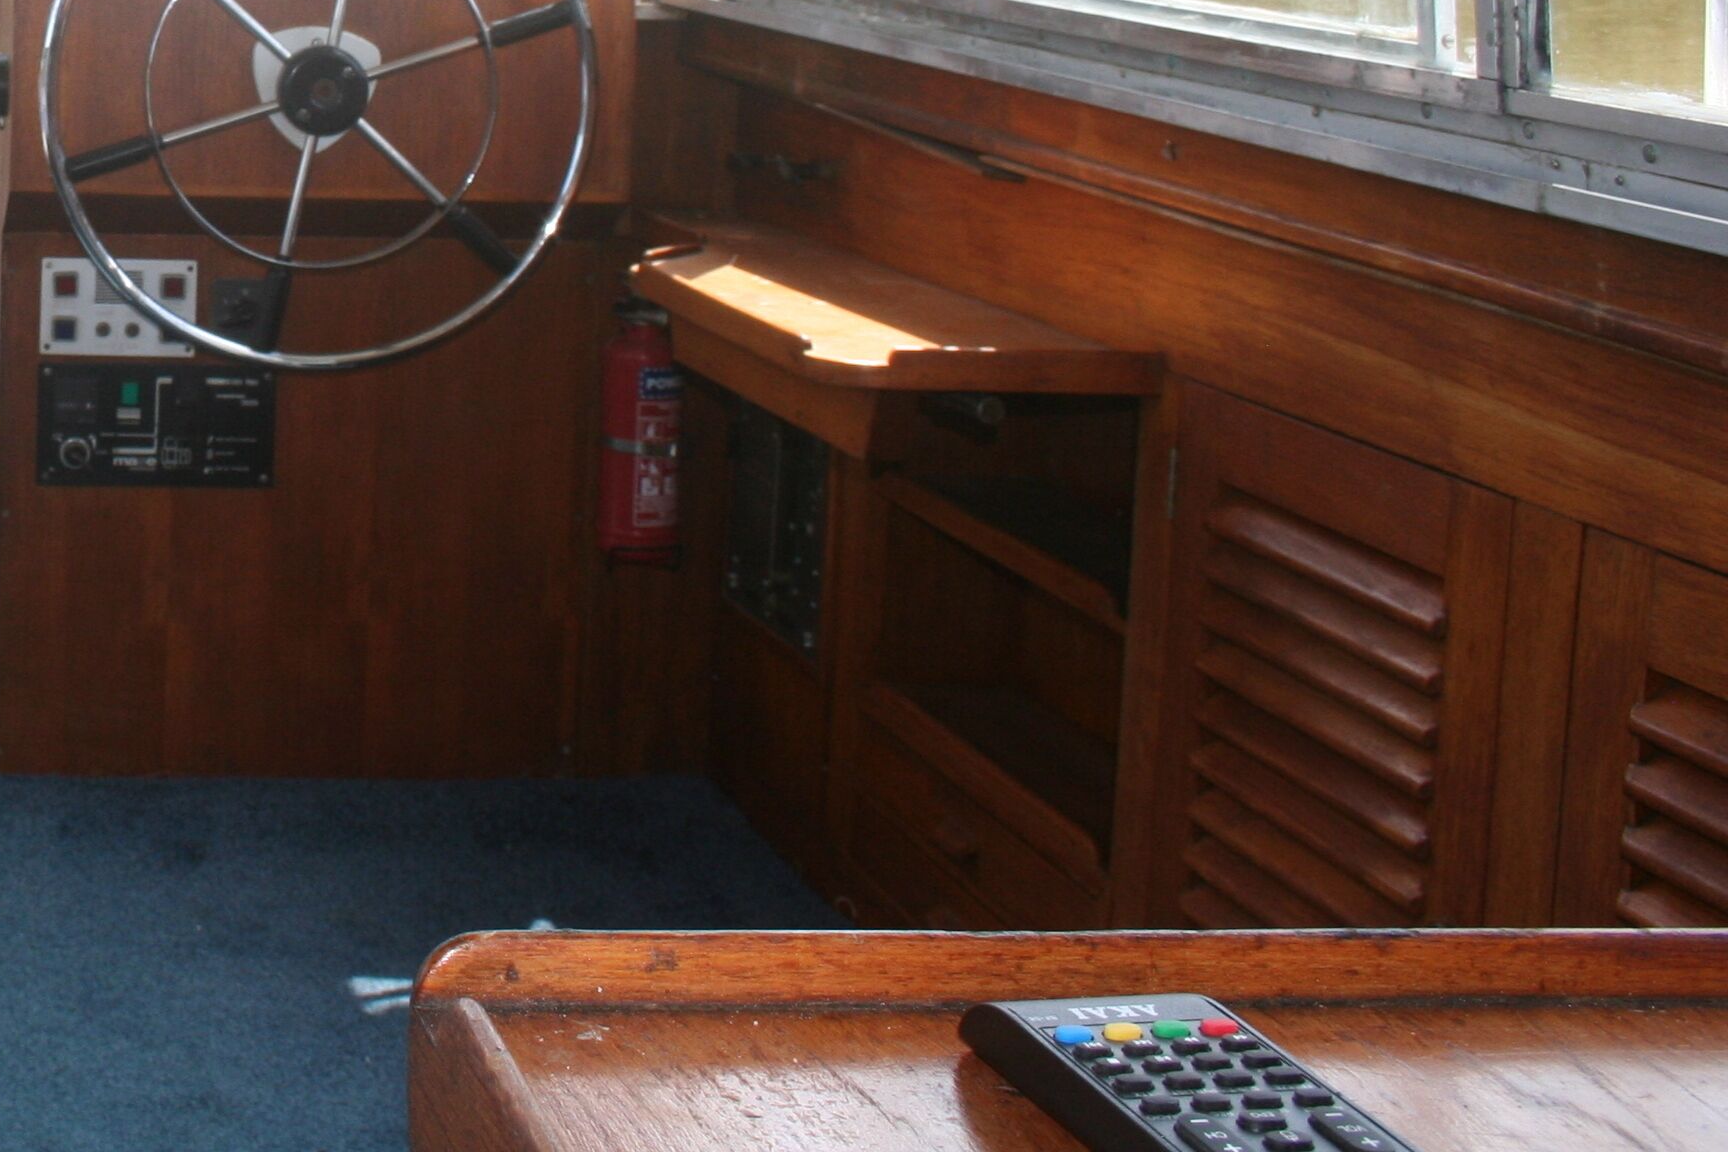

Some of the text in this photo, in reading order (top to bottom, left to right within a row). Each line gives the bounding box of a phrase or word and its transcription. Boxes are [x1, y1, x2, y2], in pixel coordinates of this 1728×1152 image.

[1068, 1003, 1159, 1020] AKAI
[1336, 1122, 1368, 1133] VOL
[1203, 1130, 1229, 1140] CH
